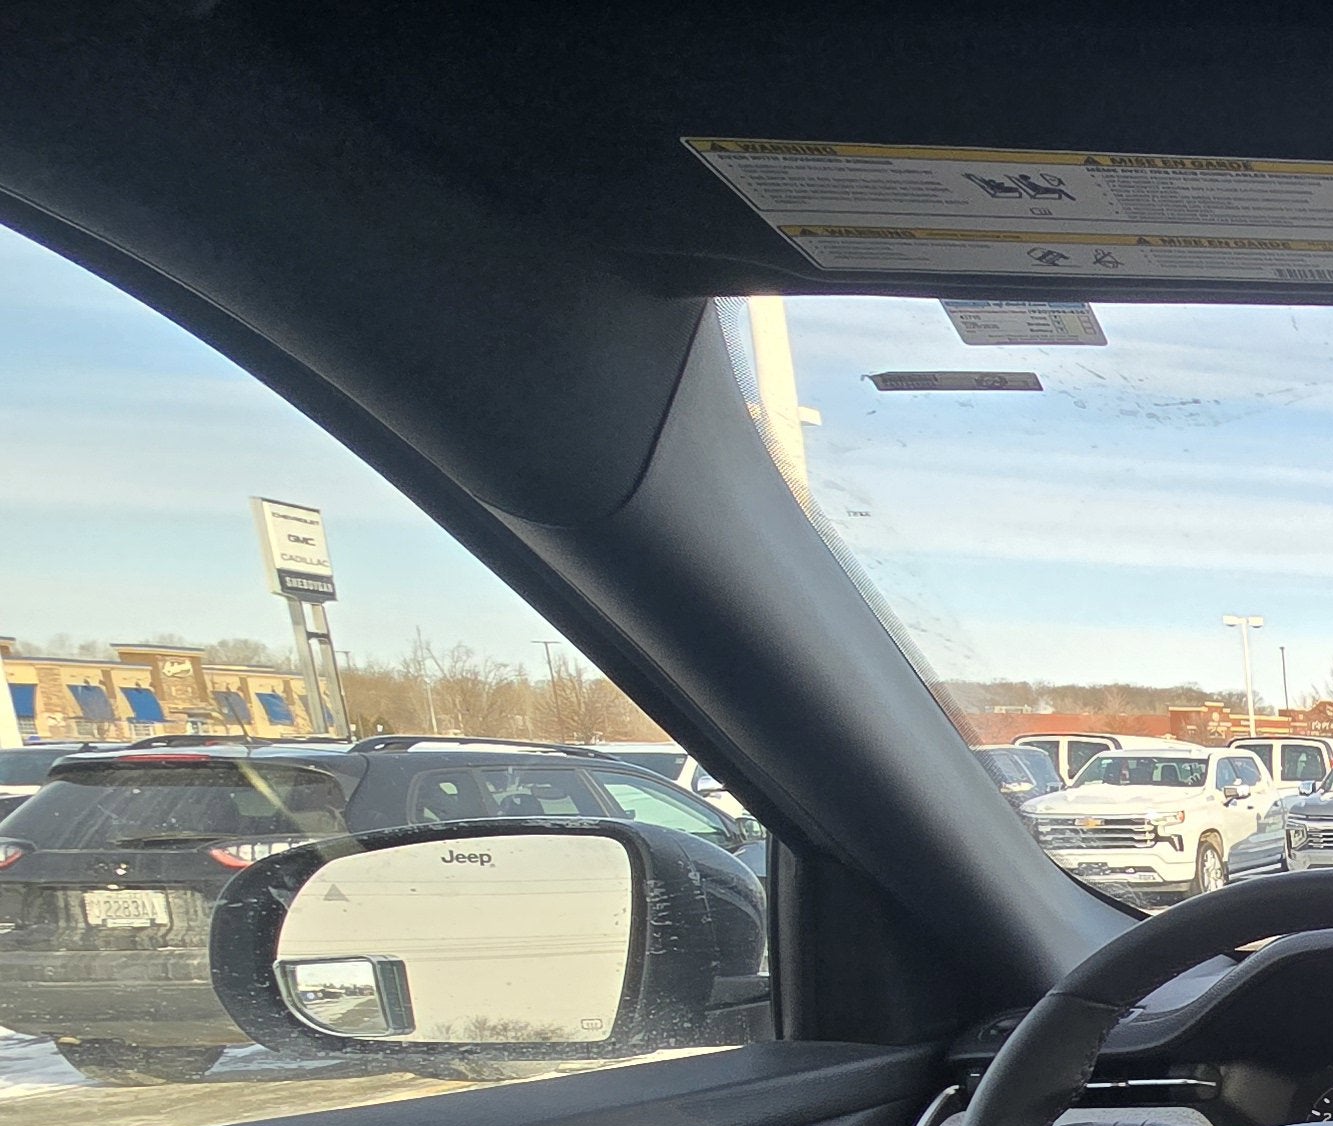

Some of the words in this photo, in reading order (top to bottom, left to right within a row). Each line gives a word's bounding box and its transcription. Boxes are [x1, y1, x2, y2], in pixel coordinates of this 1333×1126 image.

[287, 534, 316, 546] GMC
[281, 553, 330, 567] CADILLAC
[441, 850, 492, 866] Jeep
[1323, 1113, 1332, 1121] 2
